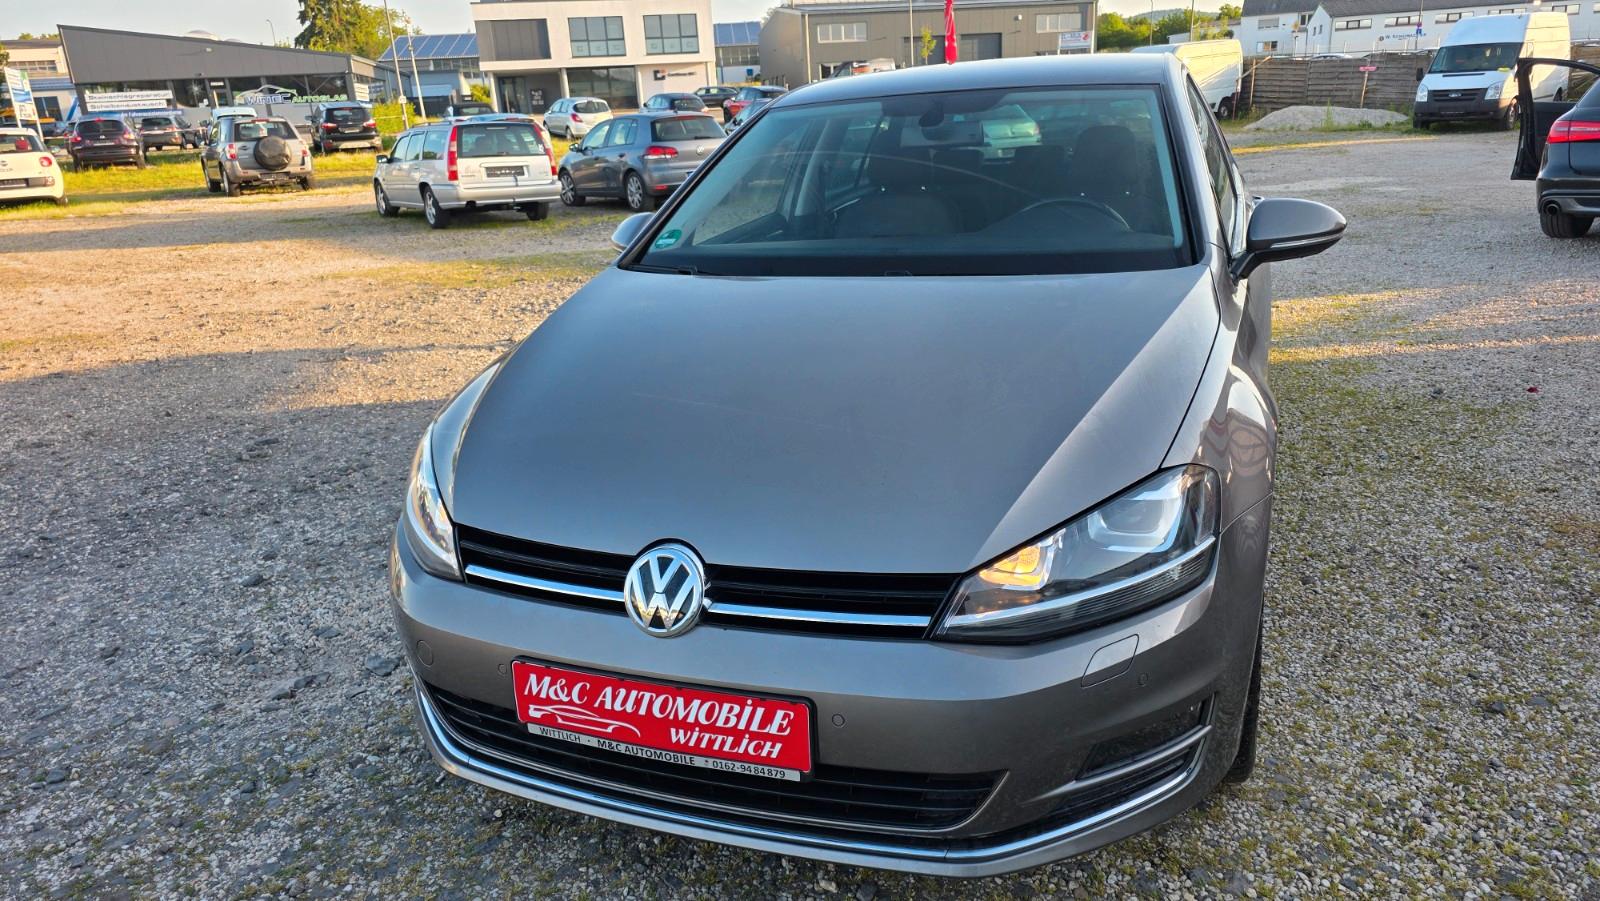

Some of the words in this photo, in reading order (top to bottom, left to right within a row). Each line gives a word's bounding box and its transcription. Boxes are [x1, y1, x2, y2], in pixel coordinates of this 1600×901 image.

[524, 673, 590, 704] M&C
[539, 727, 581, 743] WITTLICH
[597, 739, 622, 752] M&C
[624, 745, 696, 765] AUTOMOBILE
[712, 760, 786, 779] 0162-9484879
